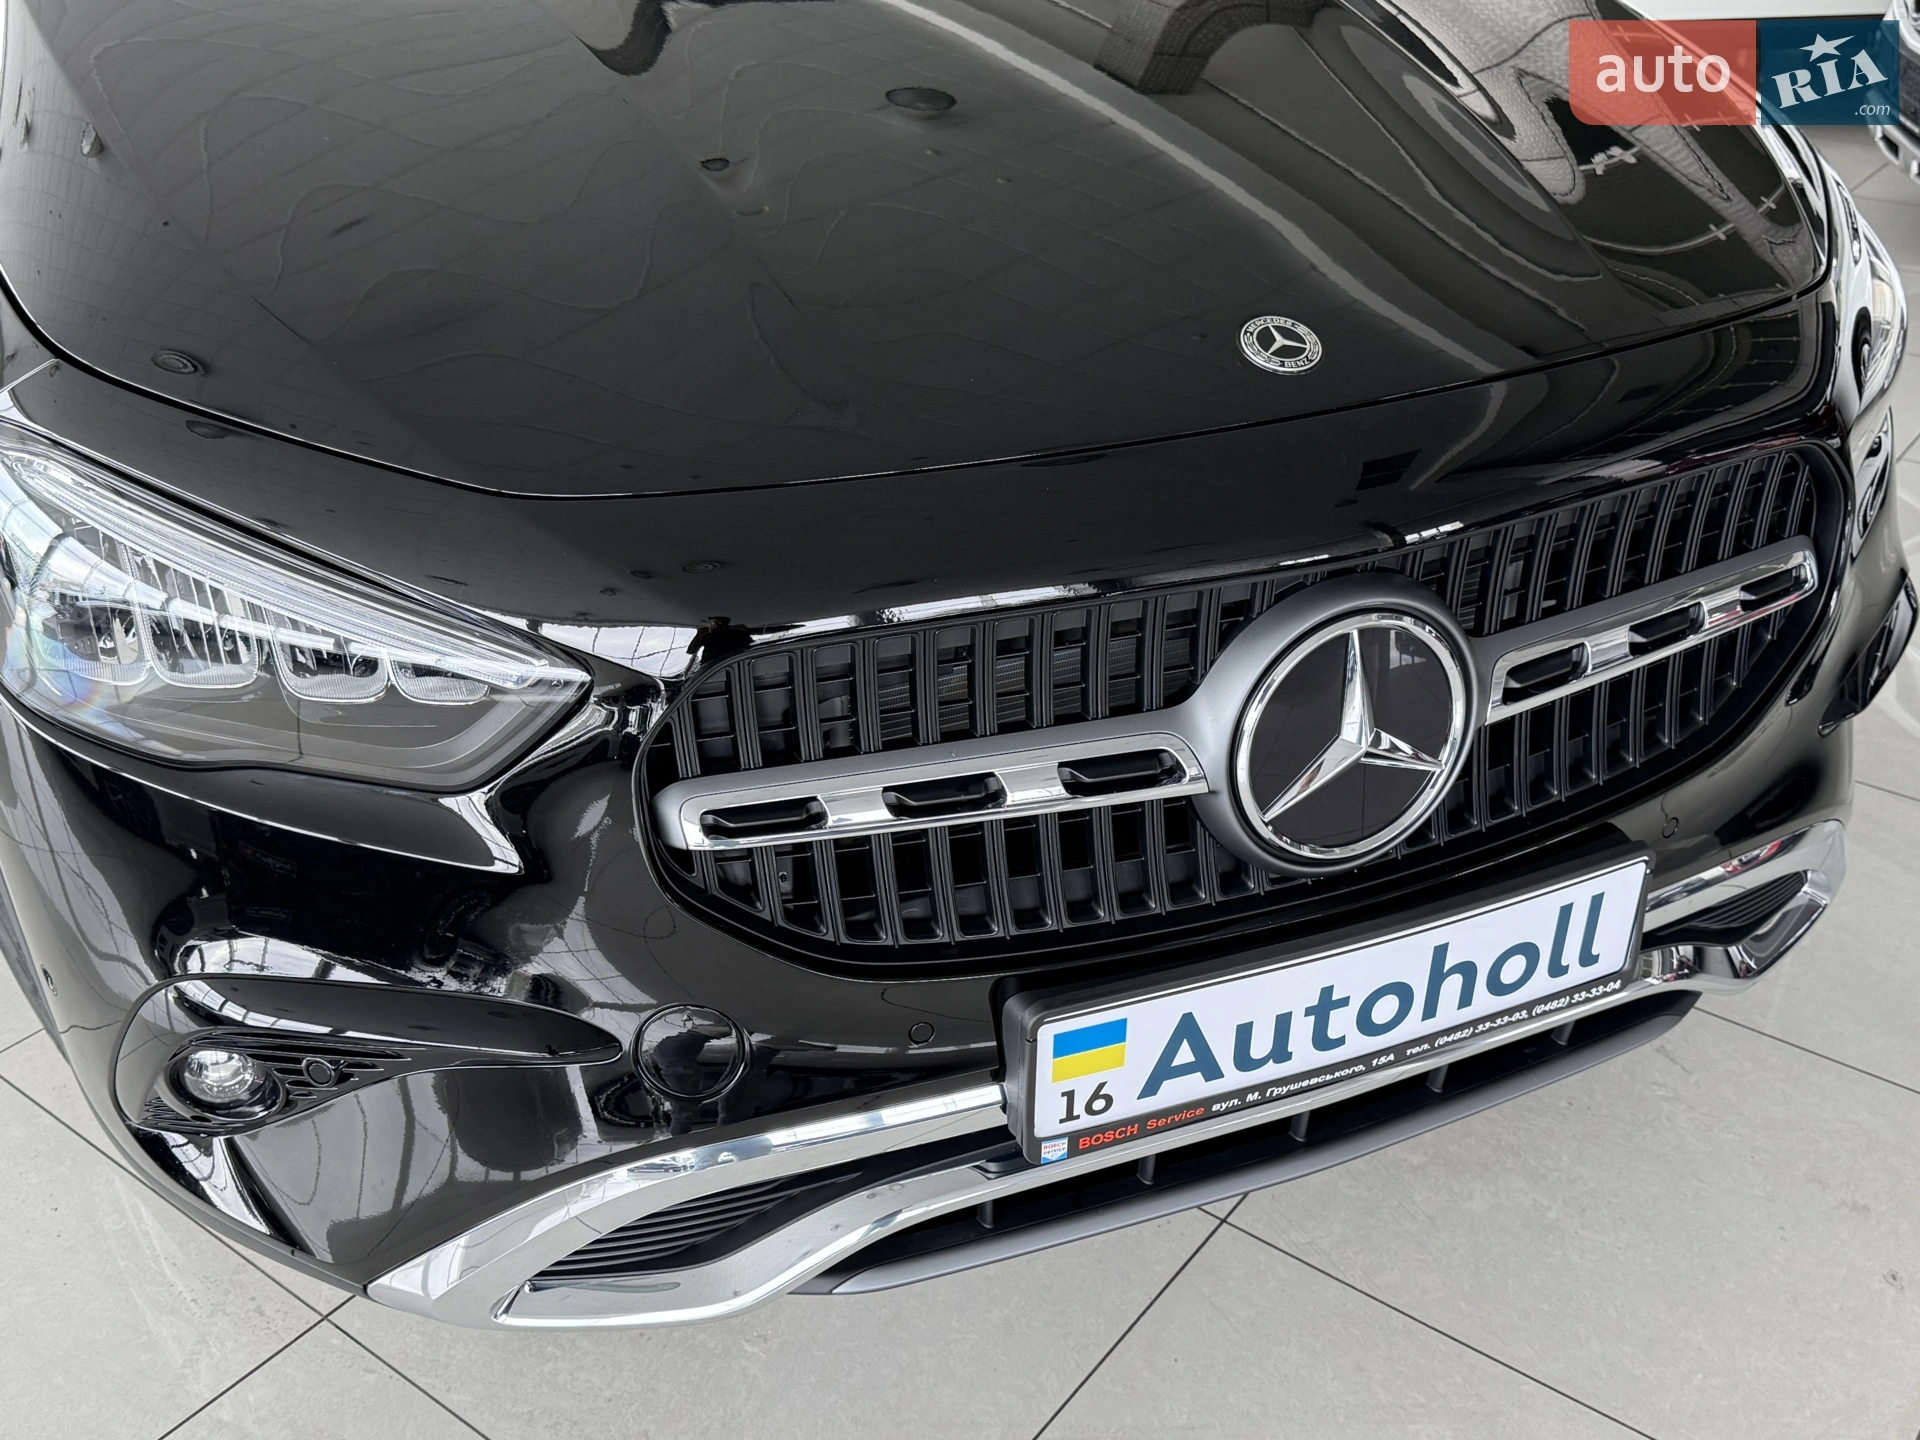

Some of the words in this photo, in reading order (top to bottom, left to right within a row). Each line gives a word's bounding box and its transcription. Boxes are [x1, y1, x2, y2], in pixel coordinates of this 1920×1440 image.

[1246, 318, 1293, 333] MERCEDES
[1284, 359, 1310, 368] BENZ
[1136, 891, 1606, 1100] Autoholl
[1079, 1124, 1139, 1150] BOSCH
[1147, 1107, 1205, 1130] Service
[1211, 1097, 1242, 1112] вул.
[1266, 1064, 1366, 1097] Грушевського,
[1406, 1043, 1431, 1056] тел.
[1434, 1027, 1474, 1048] (0482)
[1474, 1012, 1529, 1033] 33-33-03,
[1532, 996, 1570, 1017] (0482)
[1571, 979, 1622, 1003] 33-33-04
[1059, 1081, 1114, 1124] 16
[1043, 1141, 1067, 1150] BOSCH
